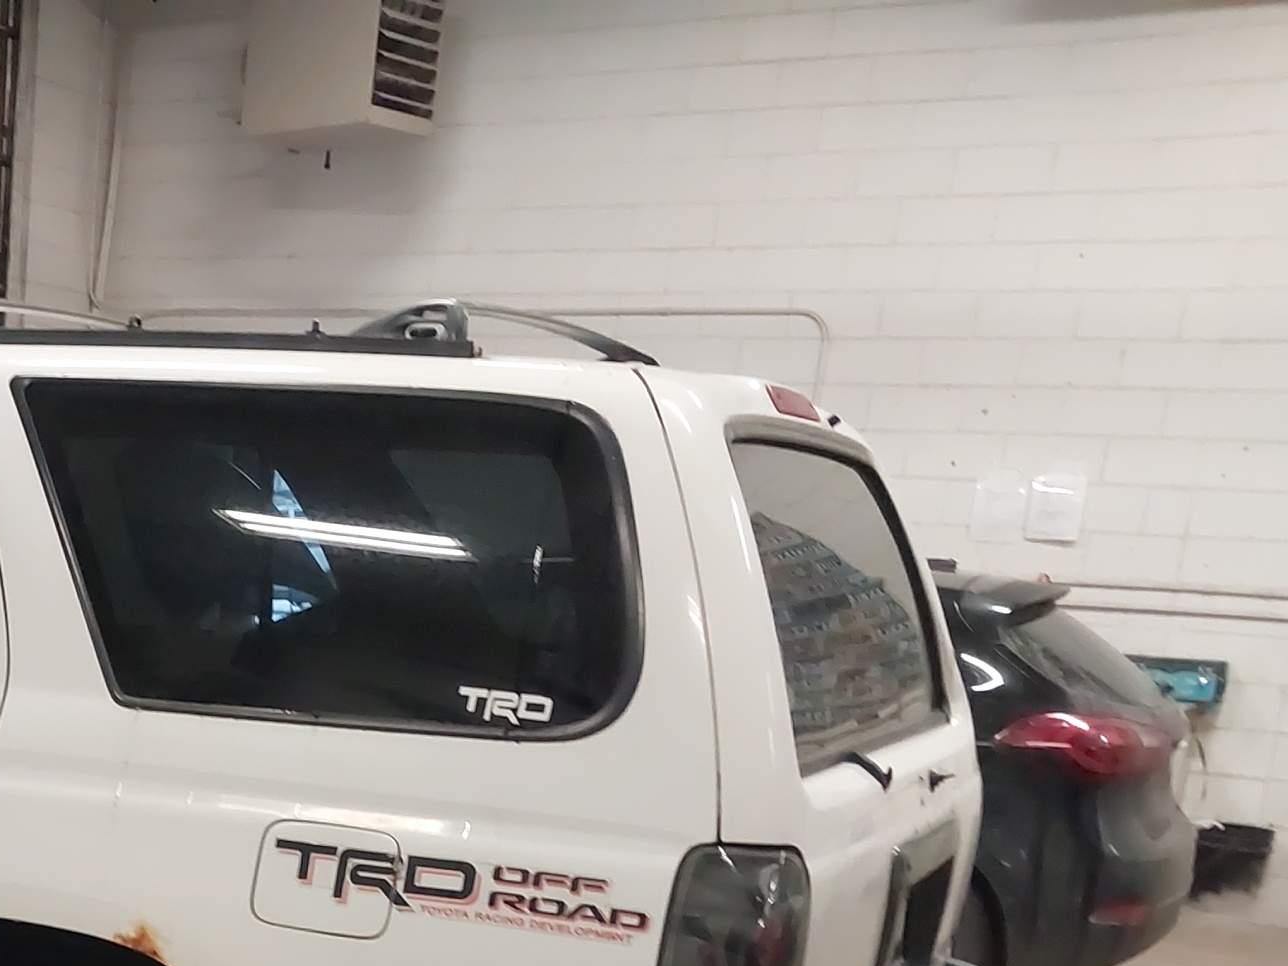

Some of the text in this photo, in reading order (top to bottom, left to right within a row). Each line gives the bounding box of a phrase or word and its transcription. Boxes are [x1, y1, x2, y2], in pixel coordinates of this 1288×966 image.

[458, 685, 554, 727] TRD
[275, 838, 481, 914] TRD
[493, 865, 610, 895] OFF
[487, 890, 650, 932] ROAD
